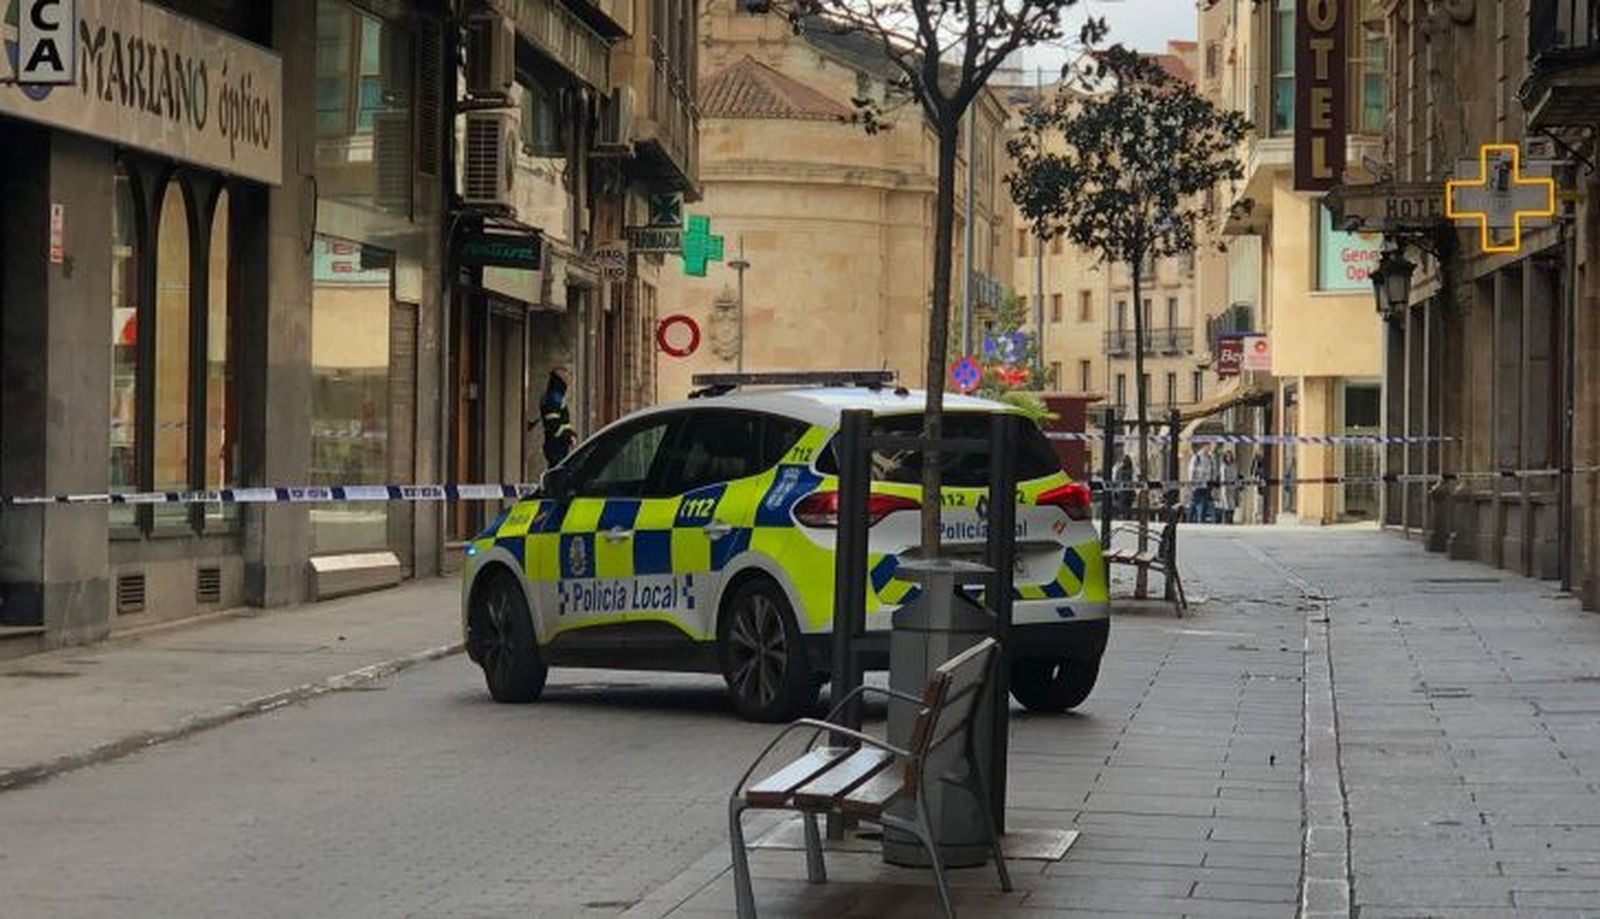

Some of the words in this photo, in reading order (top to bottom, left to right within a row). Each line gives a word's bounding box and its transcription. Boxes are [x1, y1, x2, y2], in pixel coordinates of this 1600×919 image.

[79, 18, 209, 131] MARIANO
[218, 59, 272, 161] óptico
[1385, 198, 1441, 219] HOTE
[687, 498, 715, 518] 112
[572, 579, 628, 612] Policía
[631, 577, 679, 610] Local
